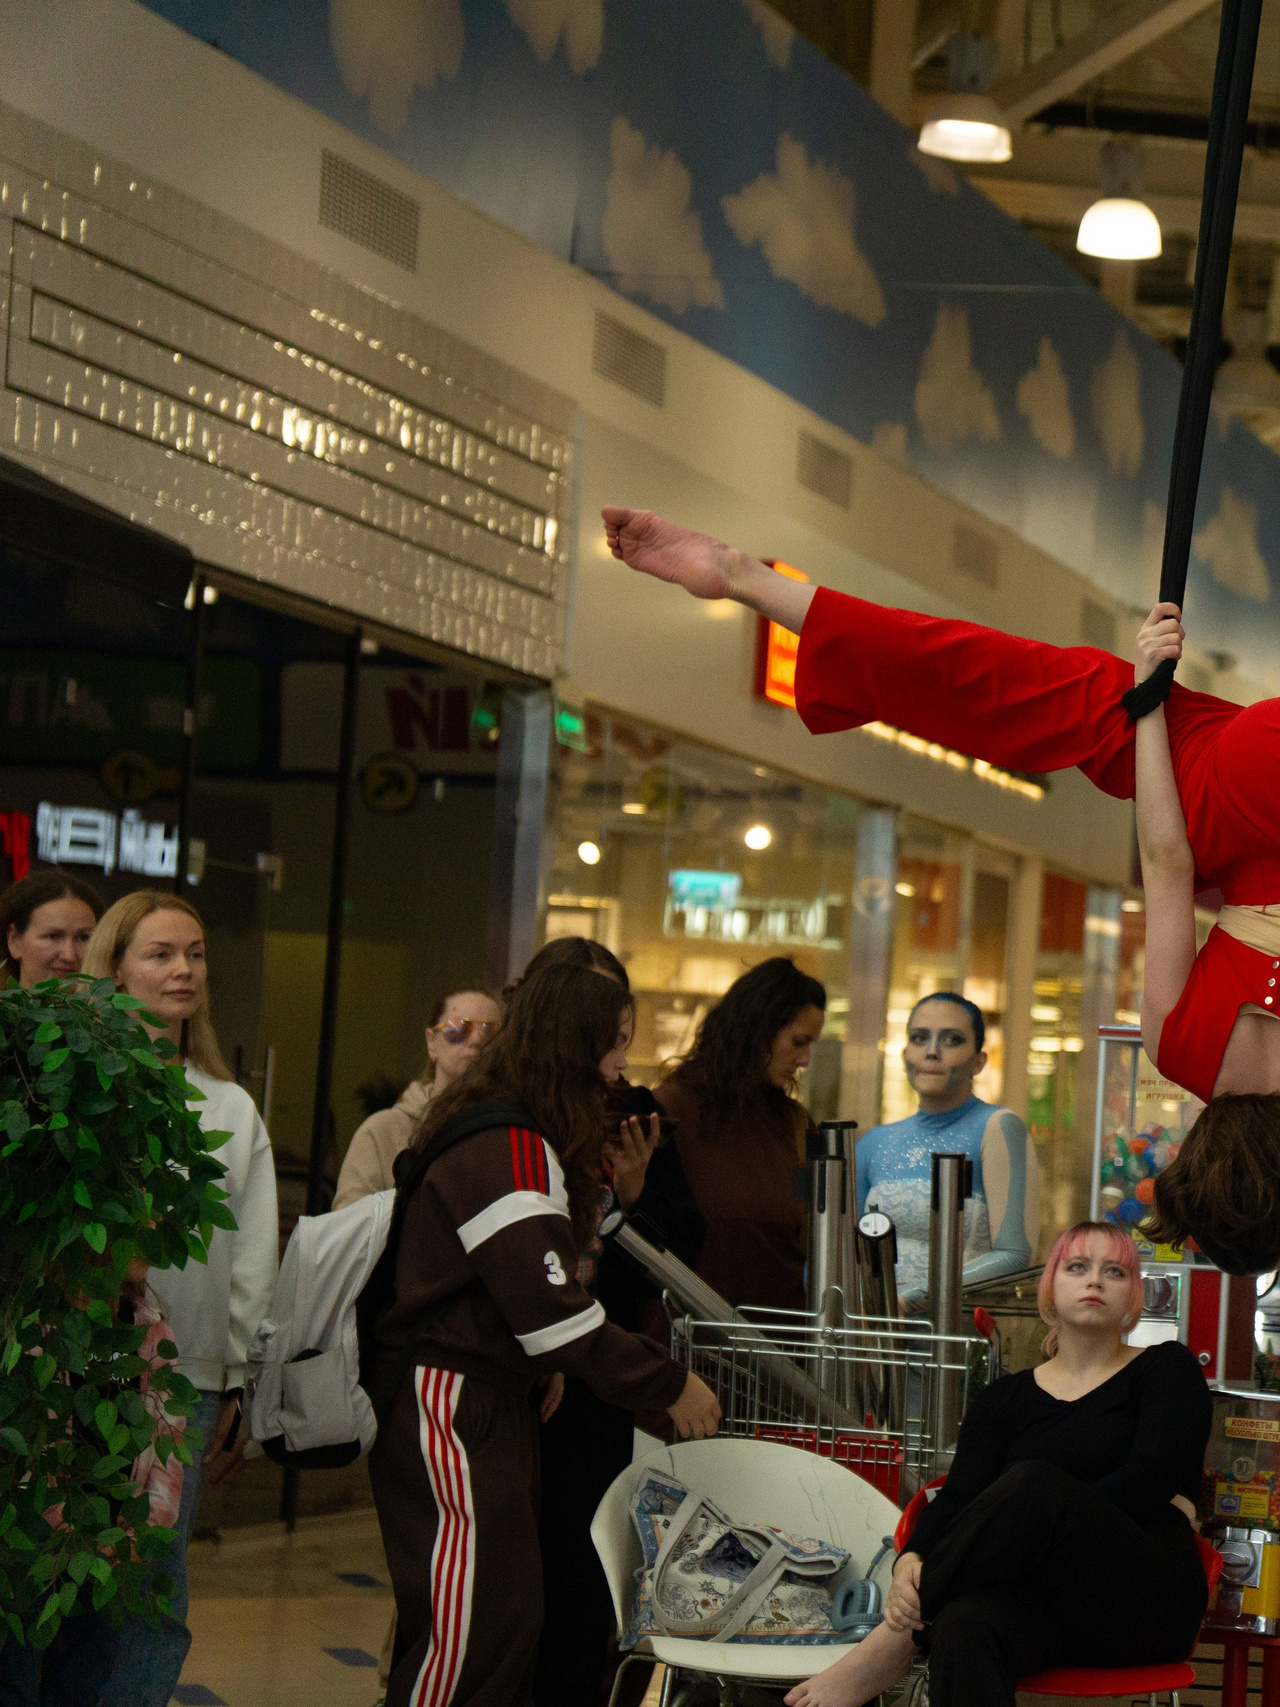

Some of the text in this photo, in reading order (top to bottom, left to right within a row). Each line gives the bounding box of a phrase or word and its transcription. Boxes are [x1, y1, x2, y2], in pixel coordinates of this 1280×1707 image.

[1146, 1092, 1184, 1100] ИГРУШКА
[543, 1250, 567, 1286] 3
[1231, 1418, 1273, 1430] КОНФЕТЫ
[1262, 1431, 1280, 1441] ШТУК
